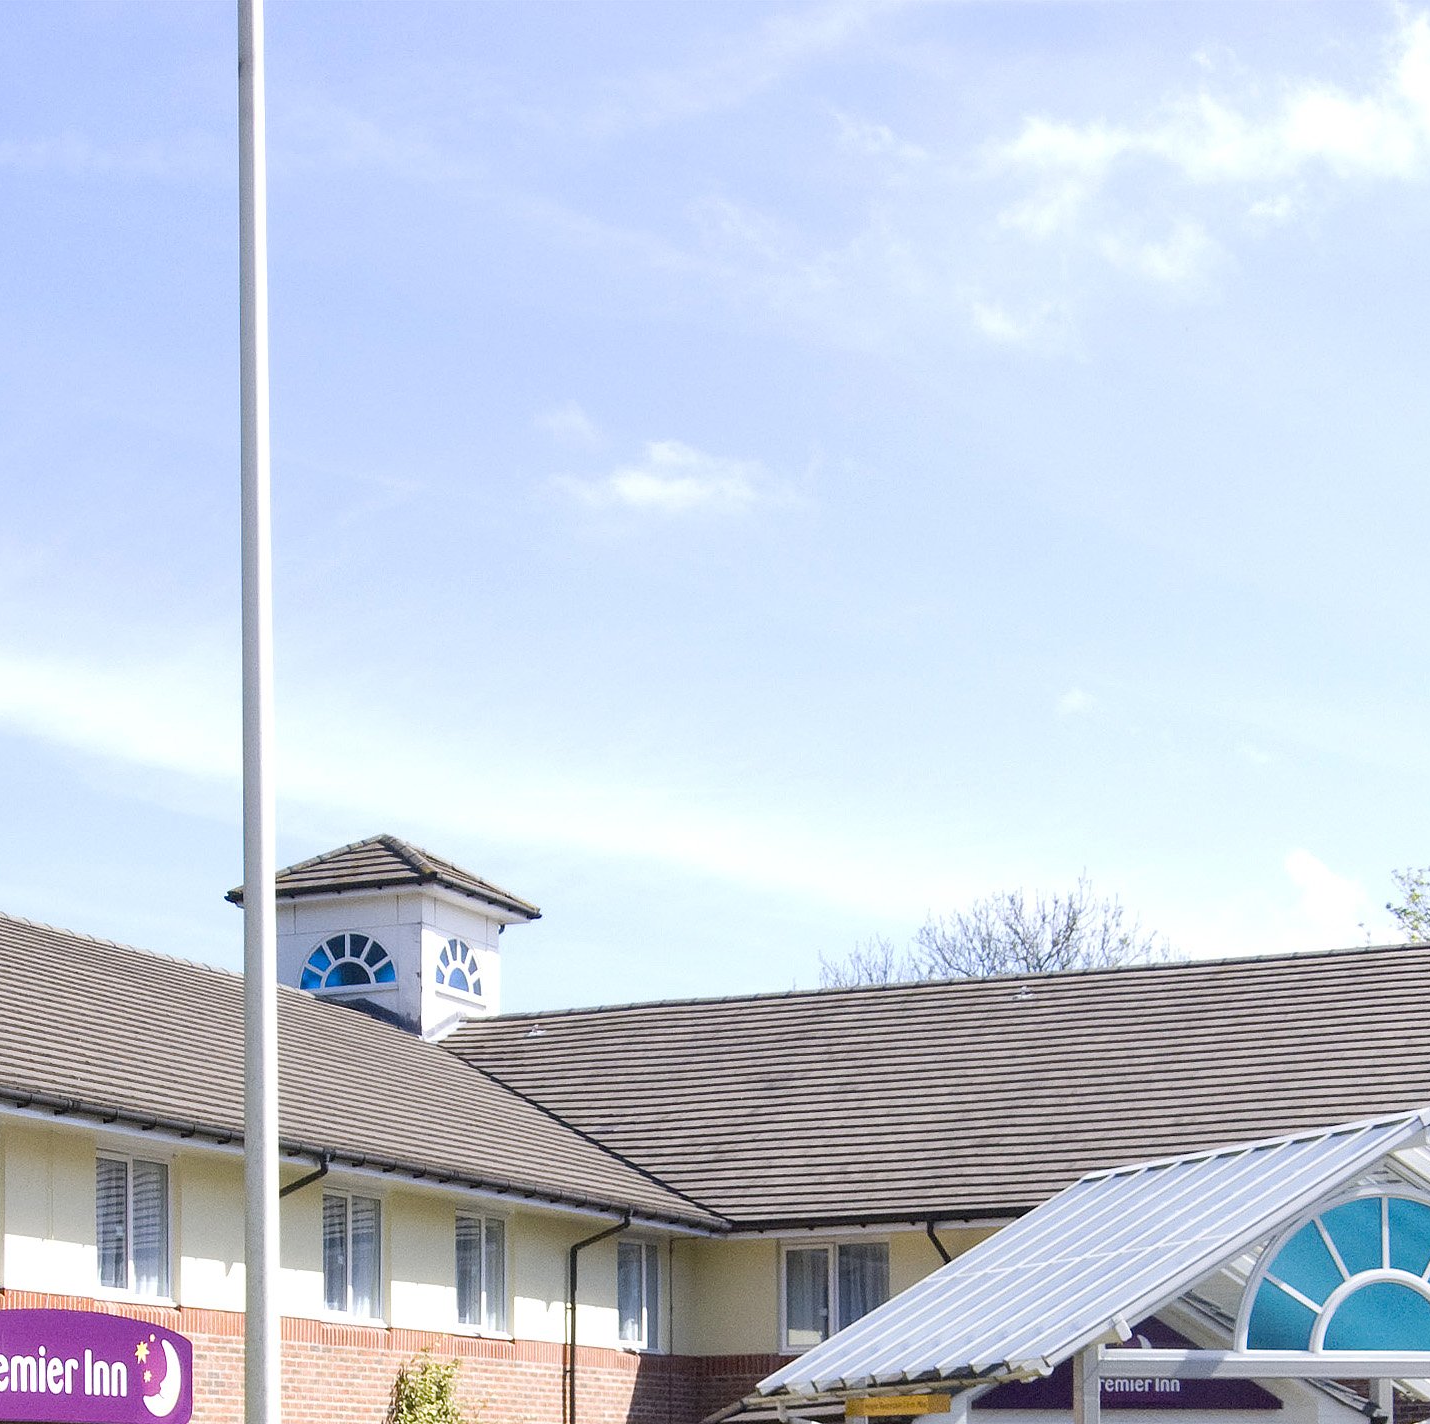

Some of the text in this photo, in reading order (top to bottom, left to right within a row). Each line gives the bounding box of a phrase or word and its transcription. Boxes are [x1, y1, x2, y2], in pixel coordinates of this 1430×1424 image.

[84, 1348, 128, 1397] Inn
[1099, 1378, 1181, 1393] remier Inn
